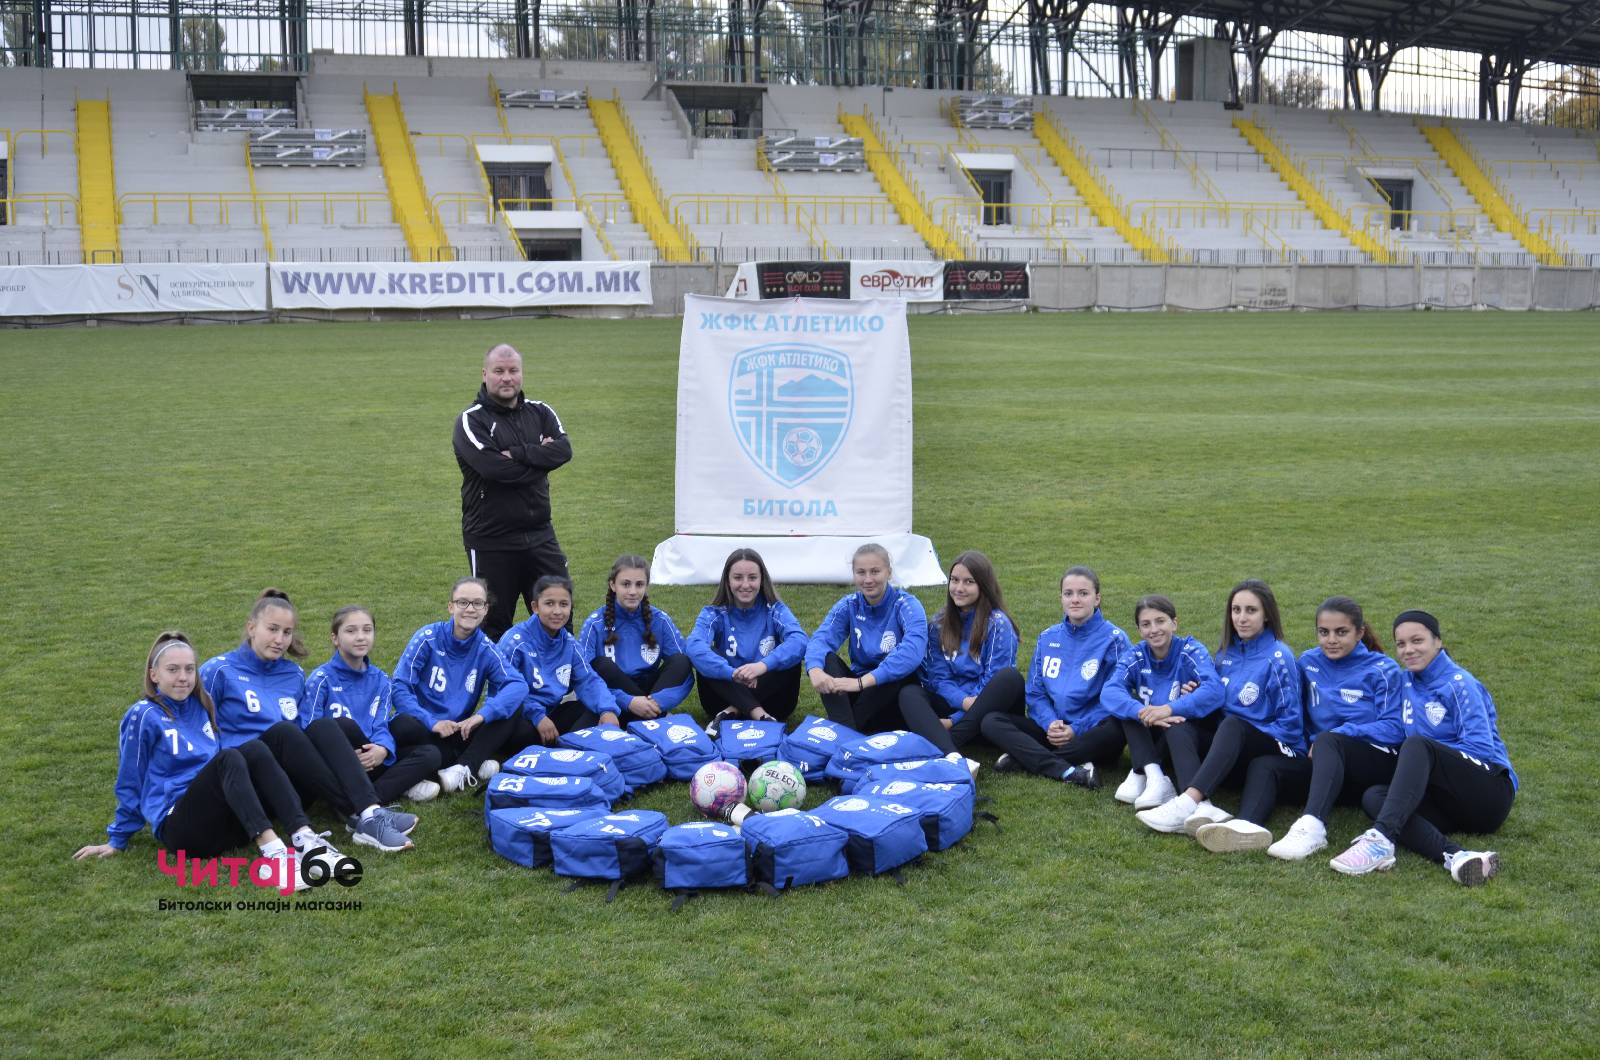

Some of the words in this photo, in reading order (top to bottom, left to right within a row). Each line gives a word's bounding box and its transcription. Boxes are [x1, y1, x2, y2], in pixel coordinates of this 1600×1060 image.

[281, 271, 641, 294] WWW.KREDITI.COM.MK
[701, 312, 757, 331] ЖФК
[763, 314, 884, 332] АТЛЕТИКО
[744, 353, 776, 371] ЖФК
[779, 352, 839, 371] АТЛЕТИКО
[743, 498, 838, 517] БИТОЛА
[1042, 656, 1061, 678] 18
[429, 666, 446, 692] 15
[245, 690, 260, 712] 6
[765, 769, 796, 788] SELECT
